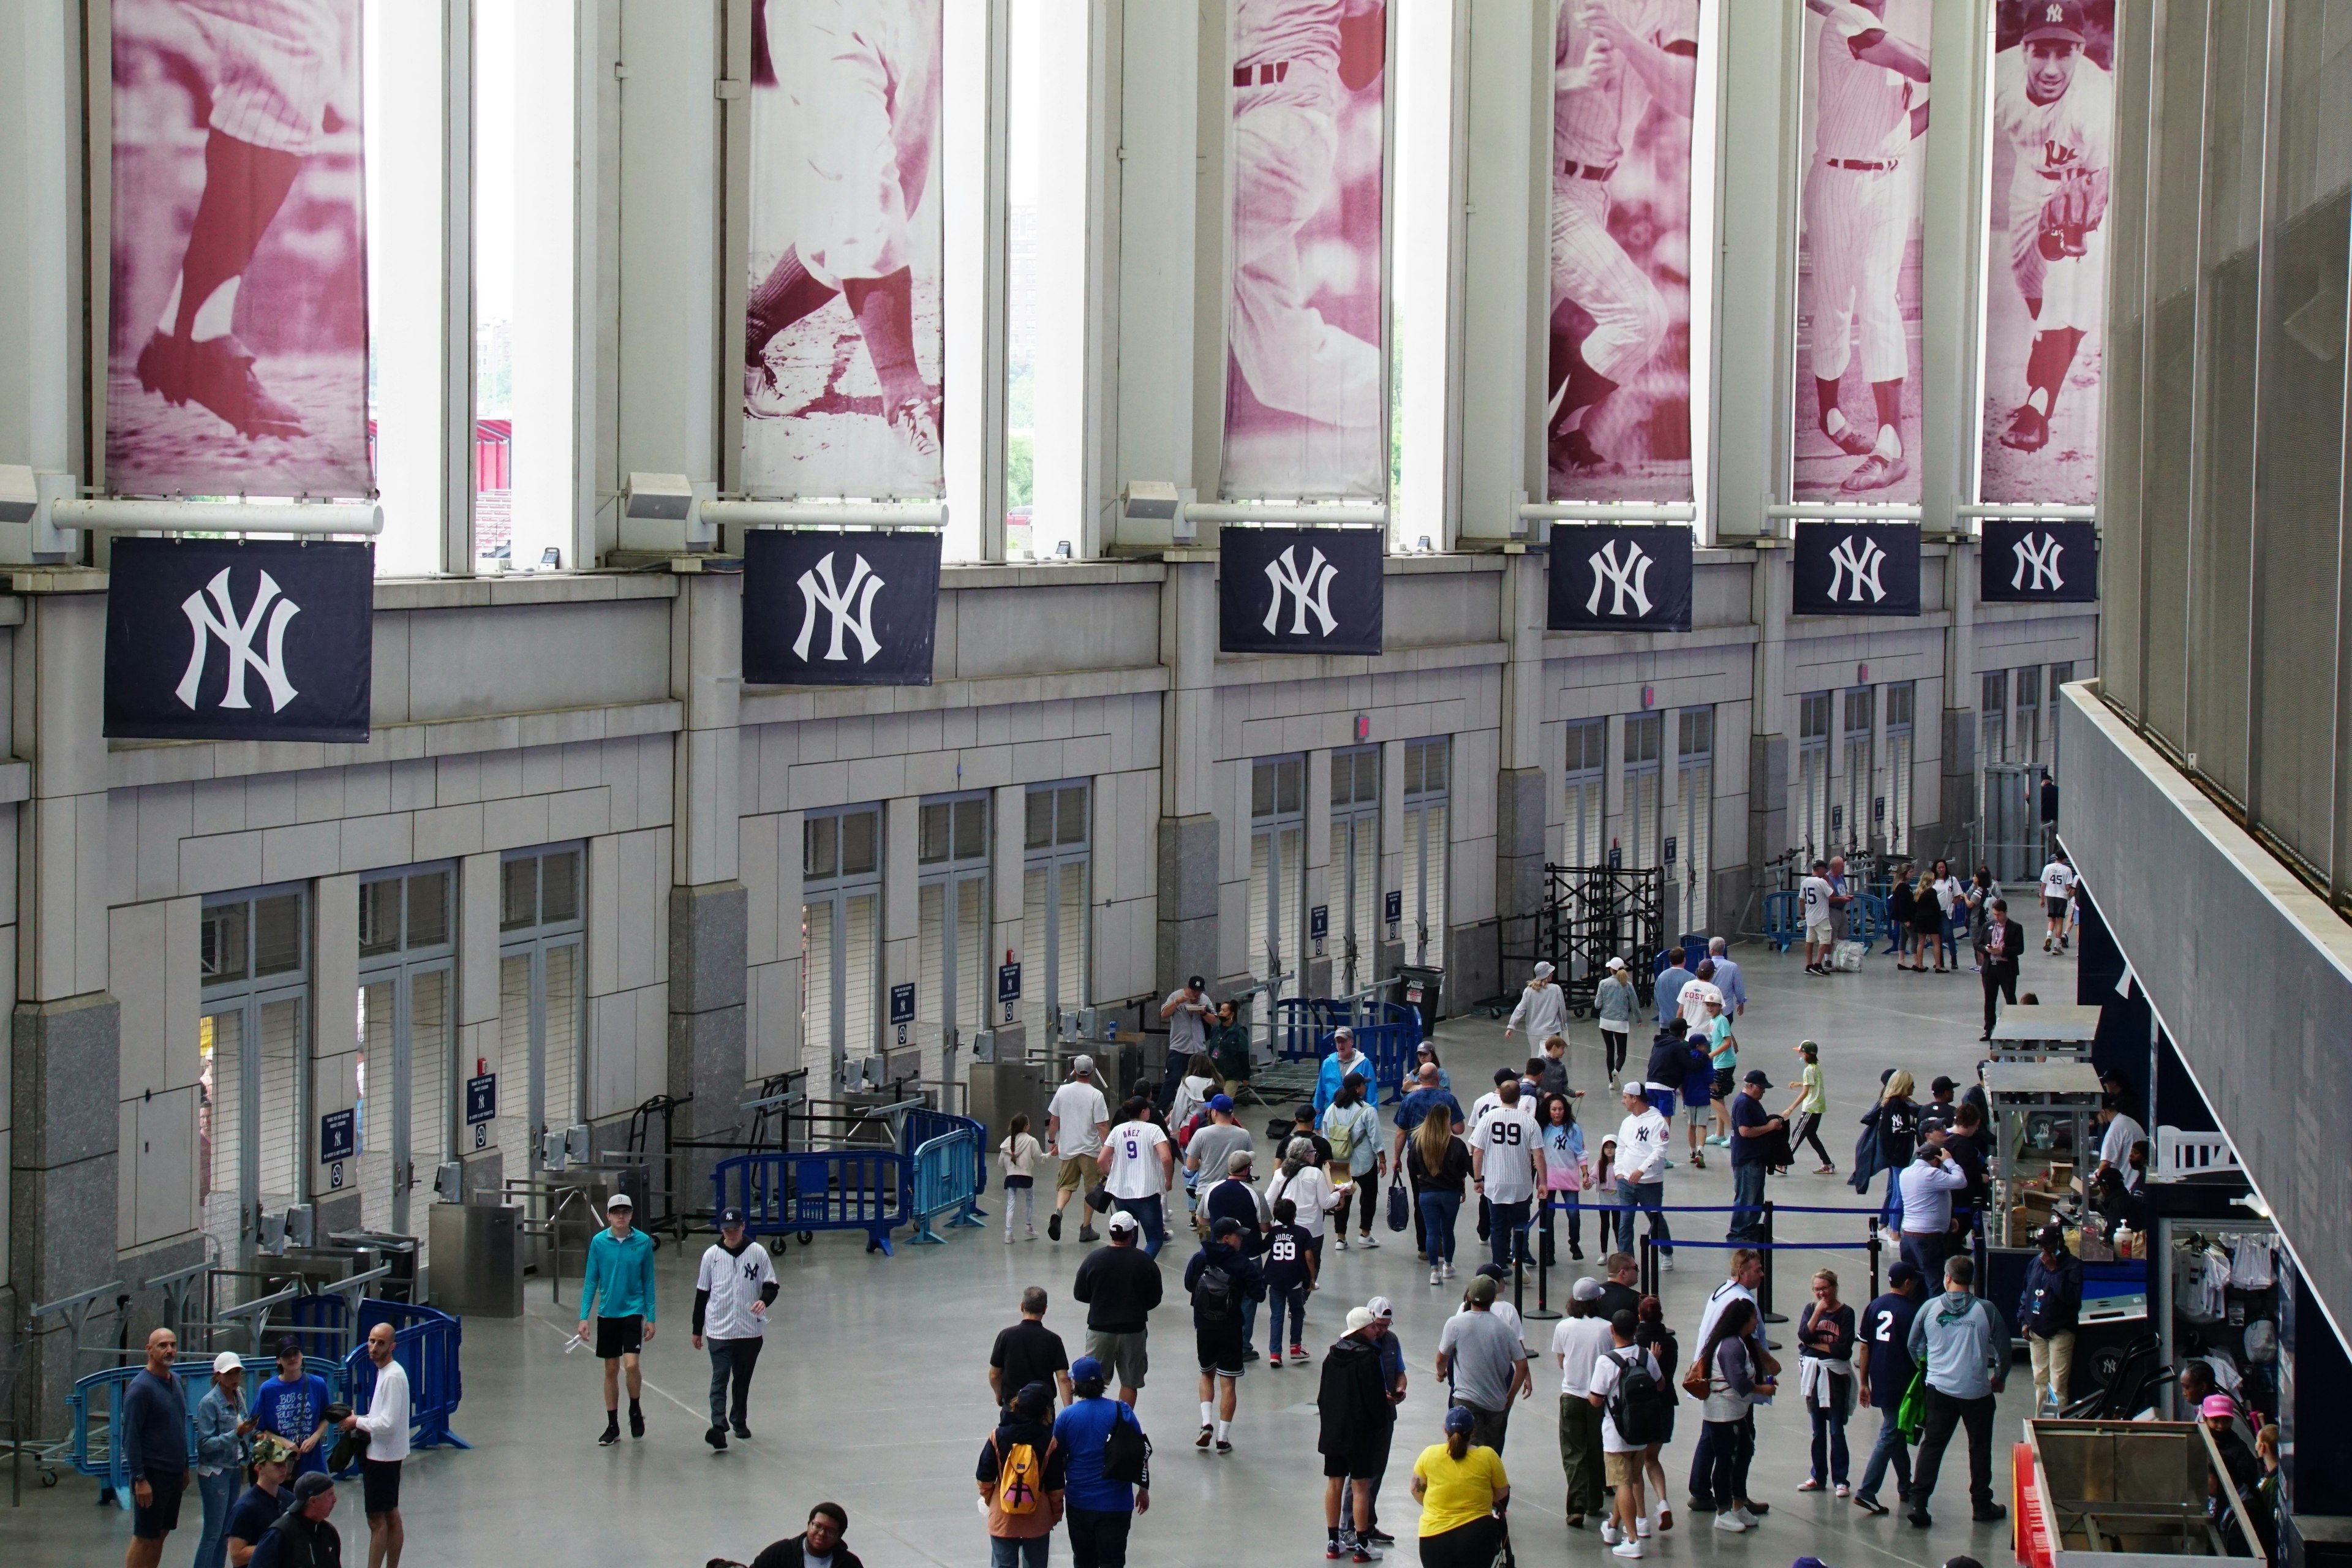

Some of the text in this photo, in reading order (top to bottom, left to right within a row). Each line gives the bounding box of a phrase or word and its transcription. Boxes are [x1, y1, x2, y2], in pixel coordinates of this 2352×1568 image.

[1827, 535, 1887, 603] NY
[2011, 532, 2064, 591] NY
[1586, 539, 1654, 617] NY
[1262, 545, 1339, 637] NY
[793, 551, 885, 664] NY
[175, 566, 301, 714] NY
[2049, 875, 2062, 884] 45
[1803, 887, 1817, 904] 15
[1685, 992, 1705, 1001] COST
[1891, 1114, 1903, 1126] NY
[1123, 1127, 1140, 1138] BÁEZ
[1492, 1121, 1521, 1145] 99
[1635, 1126, 1649, 1142] NY
[1126, 1140, 1137, 1159] 9
[1554, 1134, 1567, 1150] NY
[726, 1212, 733, 1221] NY
[1275, 1234, 1294, 1242] JUDGE
[1273, 1242, 1295, 1261] 99
[744, 1262, 760, 1281] NY
[1876, 1311, 1893, 1341] 2
[2103, 1359, 2116, 1373] NY
[279, 1392, 296, 1404] BOB
